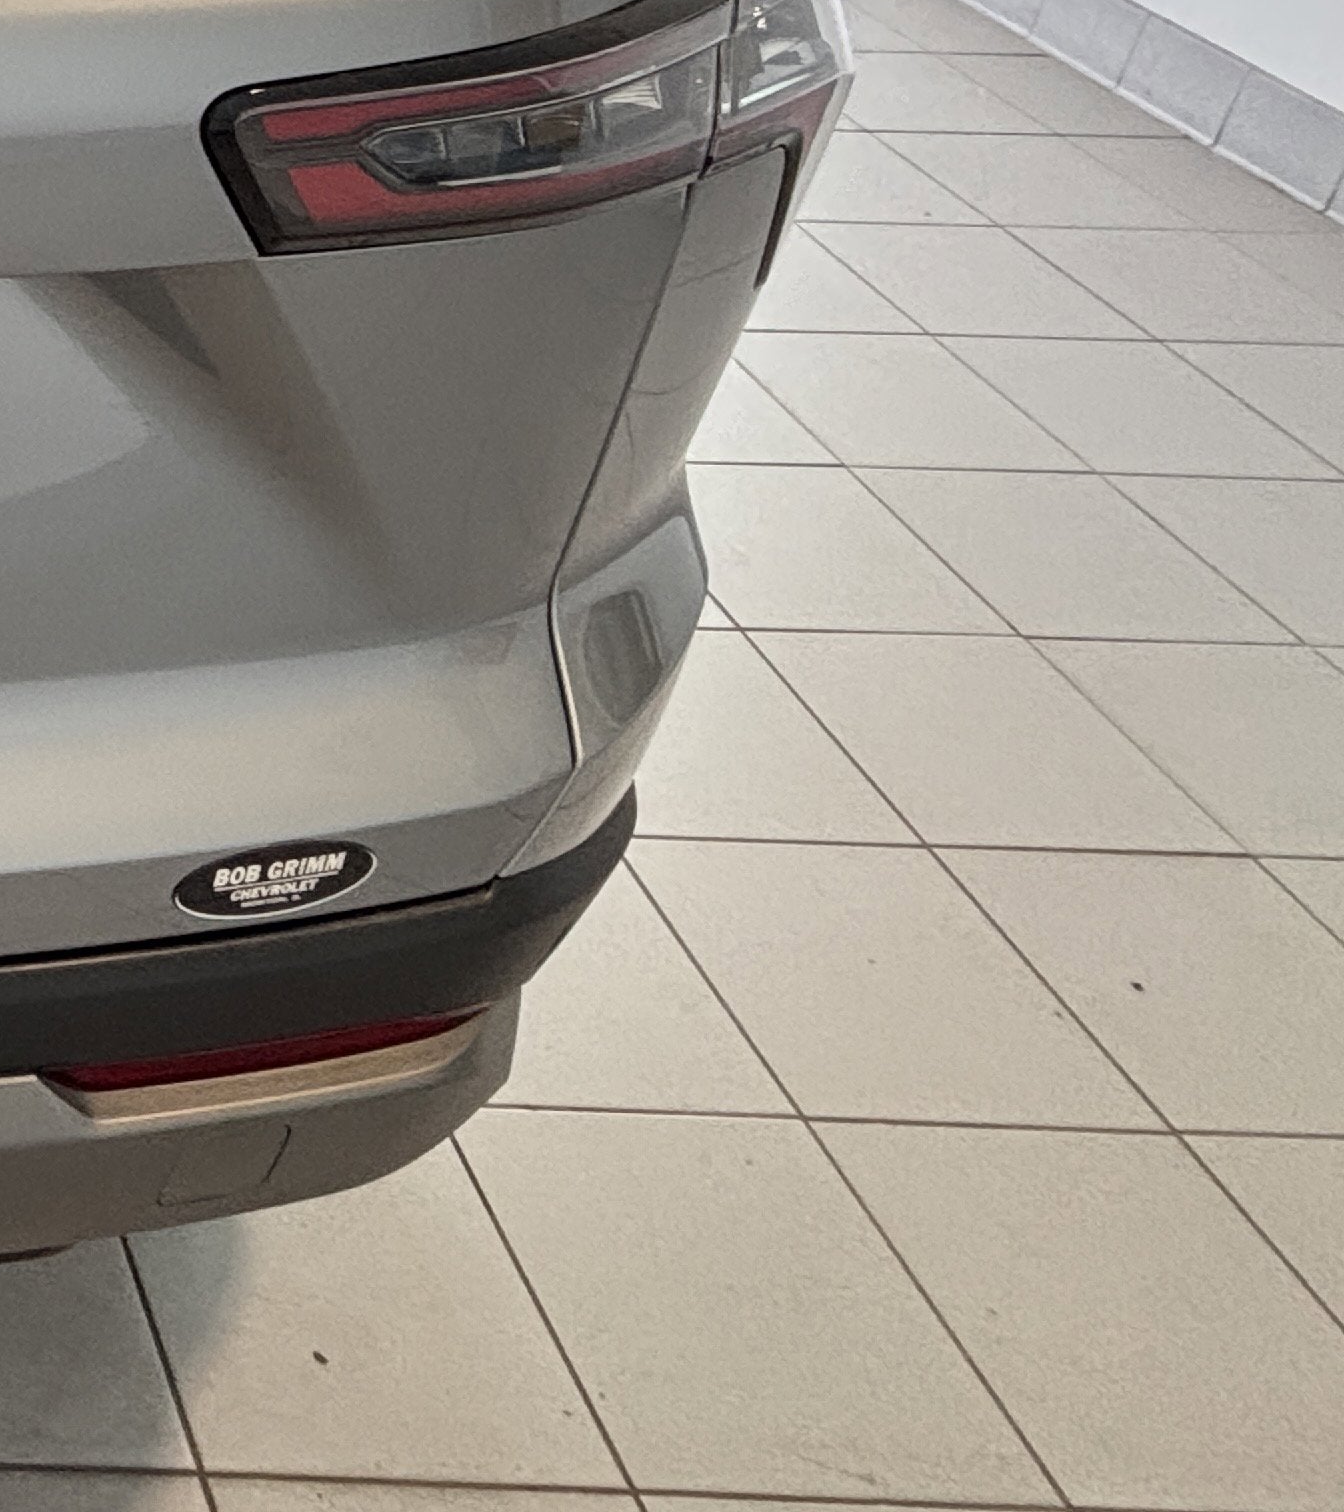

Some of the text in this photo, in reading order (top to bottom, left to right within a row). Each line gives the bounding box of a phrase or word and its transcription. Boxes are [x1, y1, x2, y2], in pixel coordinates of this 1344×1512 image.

[213, 851, 346, 887] BOB GRIMM
[230, 878, 319, 901] CHEVROLET
